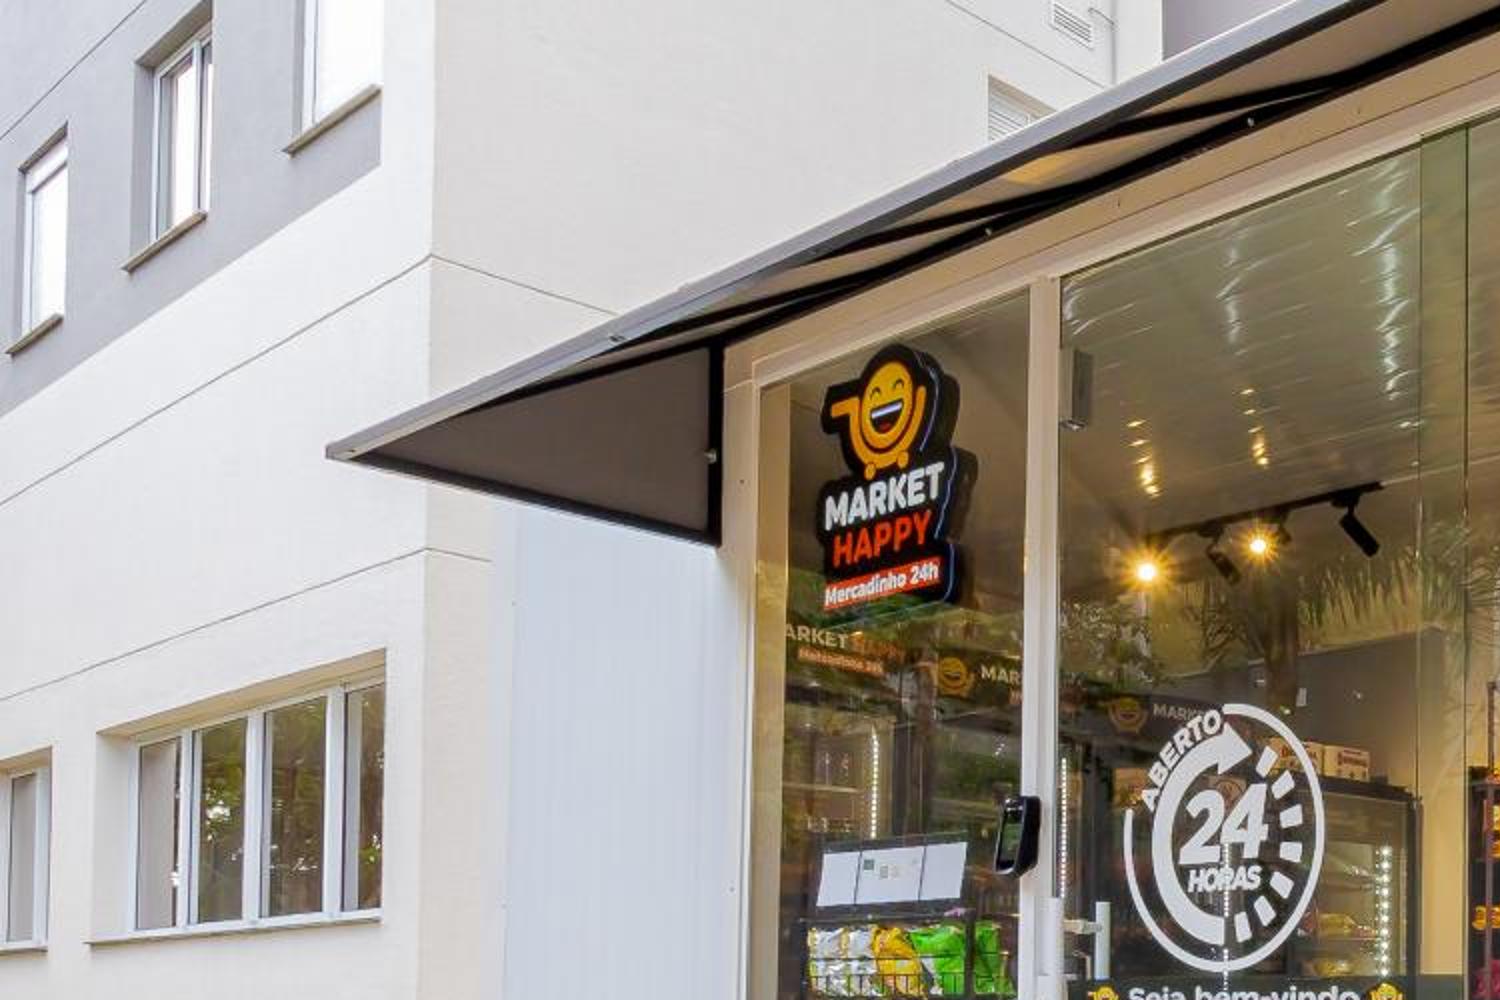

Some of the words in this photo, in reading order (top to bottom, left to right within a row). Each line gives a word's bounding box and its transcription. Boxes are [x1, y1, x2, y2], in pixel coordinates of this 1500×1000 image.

[825, 461, 945, 531] MARKET
[832, 509, 932, 568] HAPPY
[824, 571, 907, 606] Mercadinho
[910, 561, 940, 583] 24h
[786, 623, 849, 649] ARKET
[980, 664, 1022, 684] MAR
[1141, 709, 1222, 813] ABERTO
[1179, 783, 1269, 865] 24
[1188, 864, 1263, 893] HORAS
